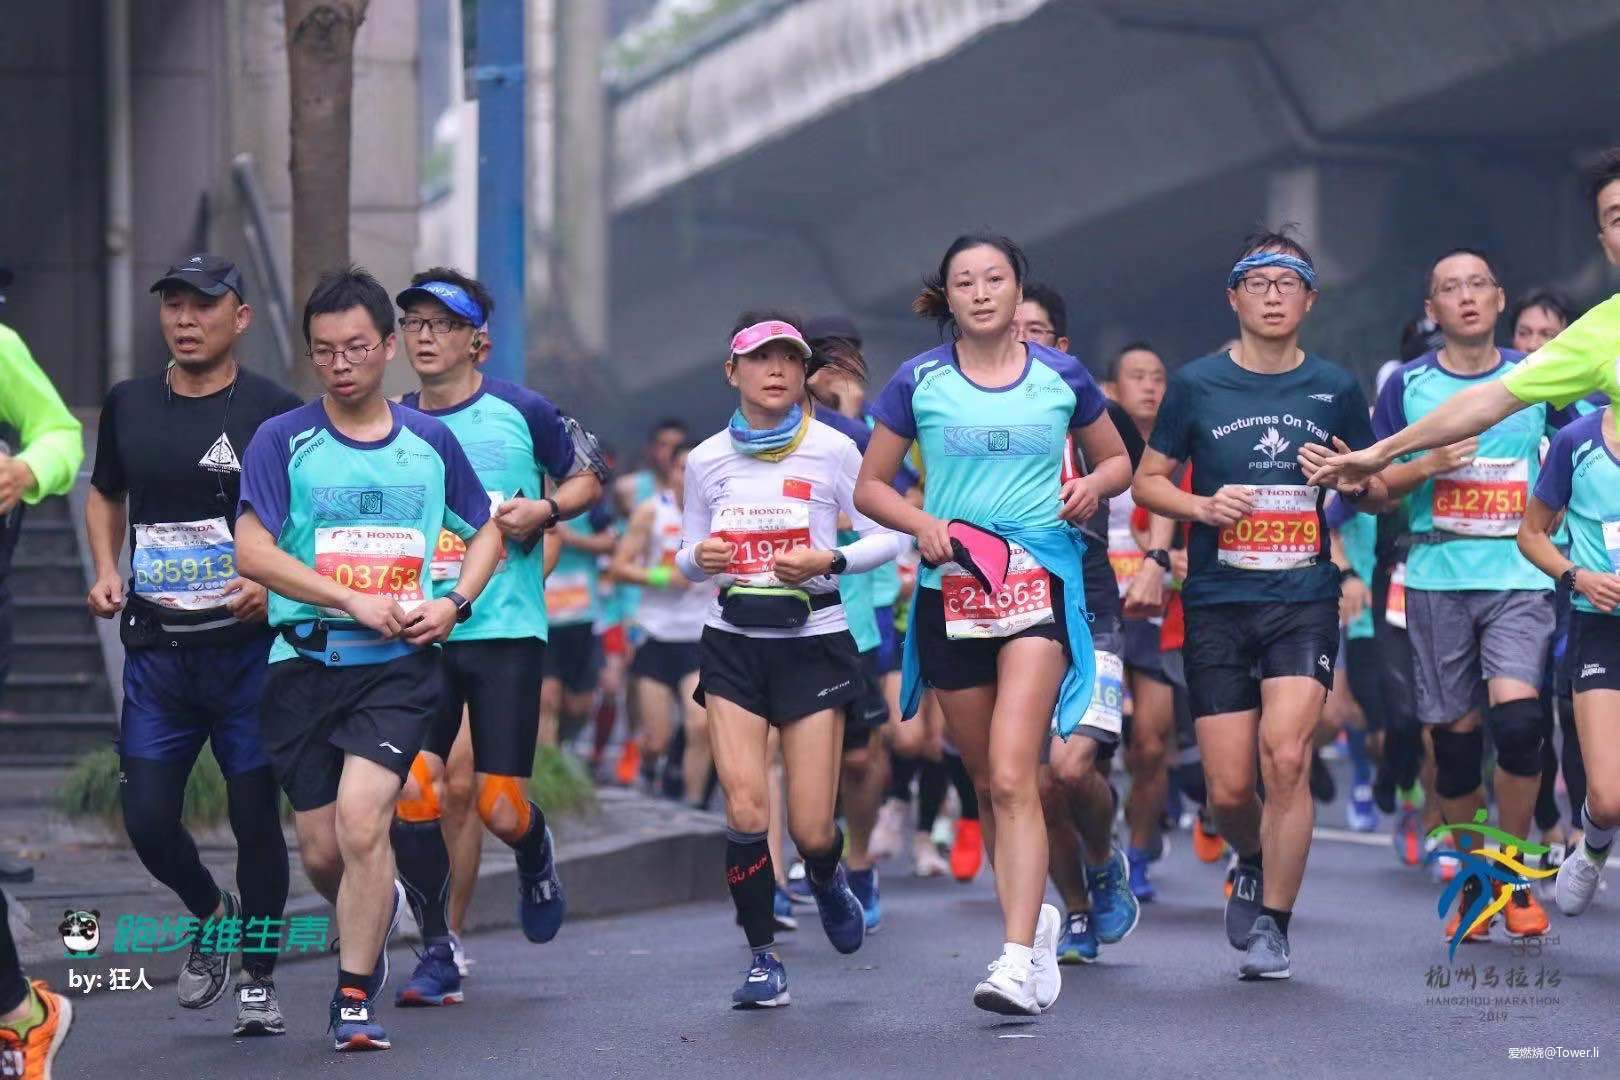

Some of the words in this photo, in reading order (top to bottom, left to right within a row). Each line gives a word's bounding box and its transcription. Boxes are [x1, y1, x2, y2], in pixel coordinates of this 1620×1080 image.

[1211, 415, 1279, 440] Nocturnes
[1282, 413, 1302, 428] On
[1305, 419, 1330, 443] Trail
[1267, 489, 1307, 497] HONDA
[749, 508, 792, 516] HONDA
[171, 523, 215, 533] HONDA
[1222, 519, 1317, 544] C02379
[366, 531, 413, 540] HONDA
[136, 553, 235, 585] D35913
